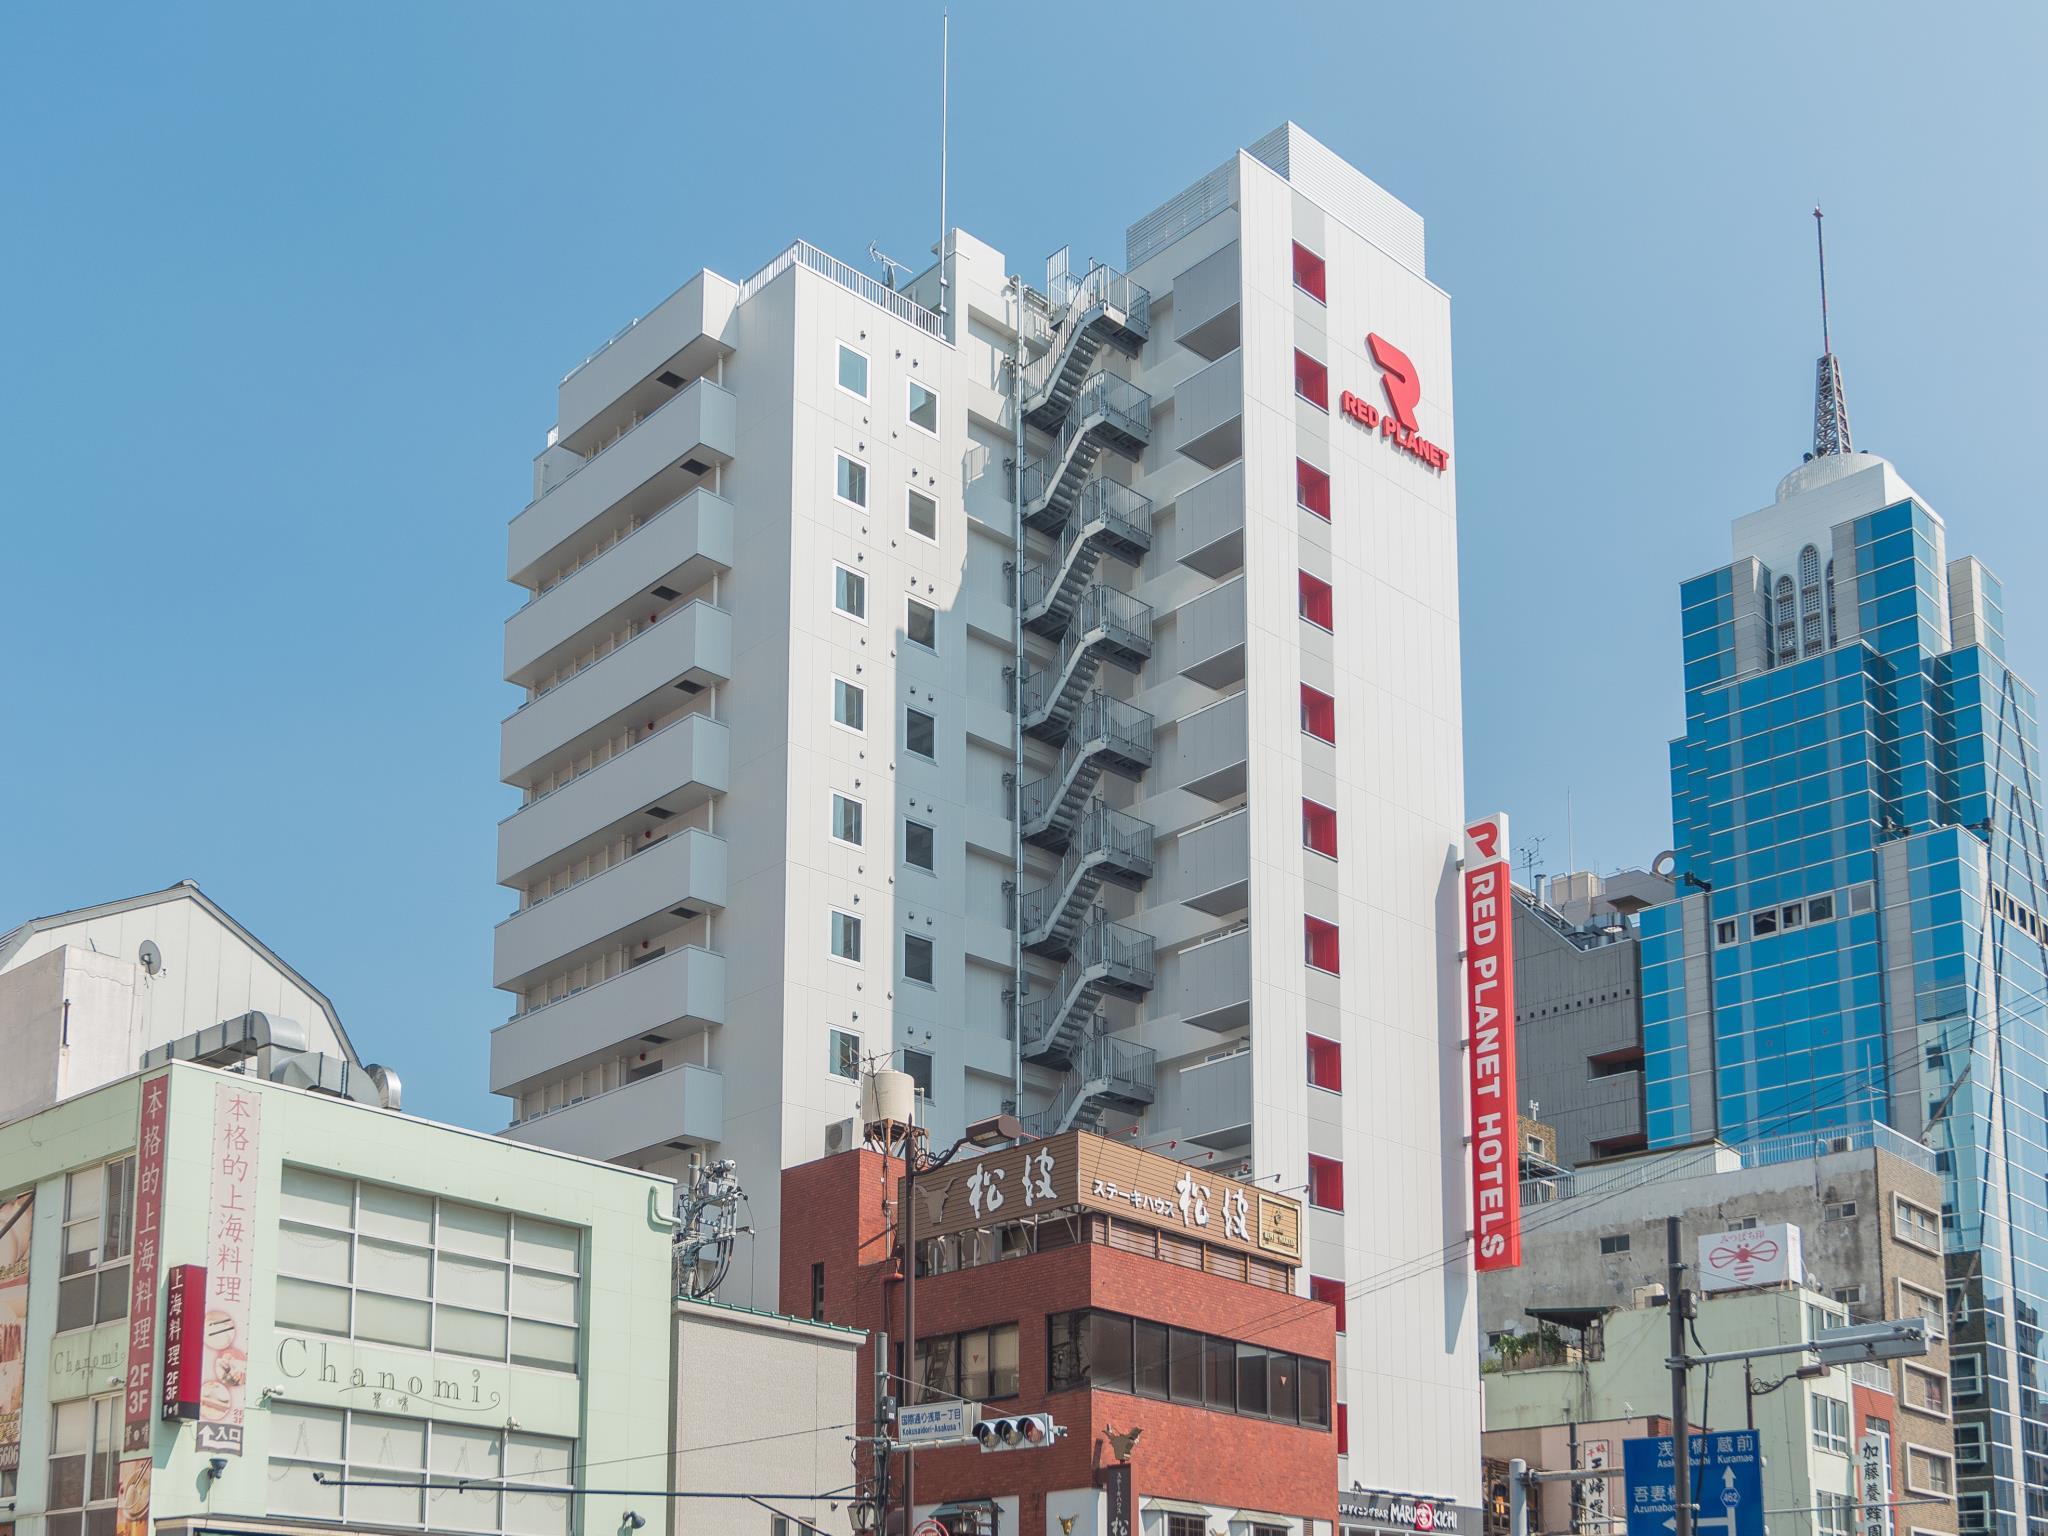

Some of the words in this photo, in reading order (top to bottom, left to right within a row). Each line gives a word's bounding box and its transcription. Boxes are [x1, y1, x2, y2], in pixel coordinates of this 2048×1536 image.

[1340, 390, 1379, 429] RED
[1381, 415, 1449, 472] PLANET
[1472, 871, 1496, 946] RED
[1474, 955, 1500, 1098] PLANET
[216, 1094, 251, 1303] 本格的上海料理
[1093, 1179, 1174, 1218] ステーキハウス
[1478, 1112, 1505, 1258] HOTELS
[133, 1086, 162, 1349] 本格的上海料理
[167, 1269, 183, 1367] 上海料理
[129, 1363, 150, 1388] 2F
[166, 1371, 179, 1385] 2F
[276, 1337, 482, 1403] Chanomi
[129, 1389, 149, 1414] 3F
[166, 1386, 178, 1400] 3F
[901, 1408, 961, 1425] 国際通り浅草一丁目
[215, 1427, 241, 1442] 入口
[1658, 1439, 1708, 1457] 浅橋
[1716, 1434, 1754, 1453] 蔵前
[1717, 1455, 1754, 1464] Kuramae
[1723, 1493, 1738, 1502] 462
[1863, 1442, 1882, 1536] 加藤養蜂園
[1390, 1503, 1417, 1525] MARU
[1434, 1508, 1458, 1529] KICHI
